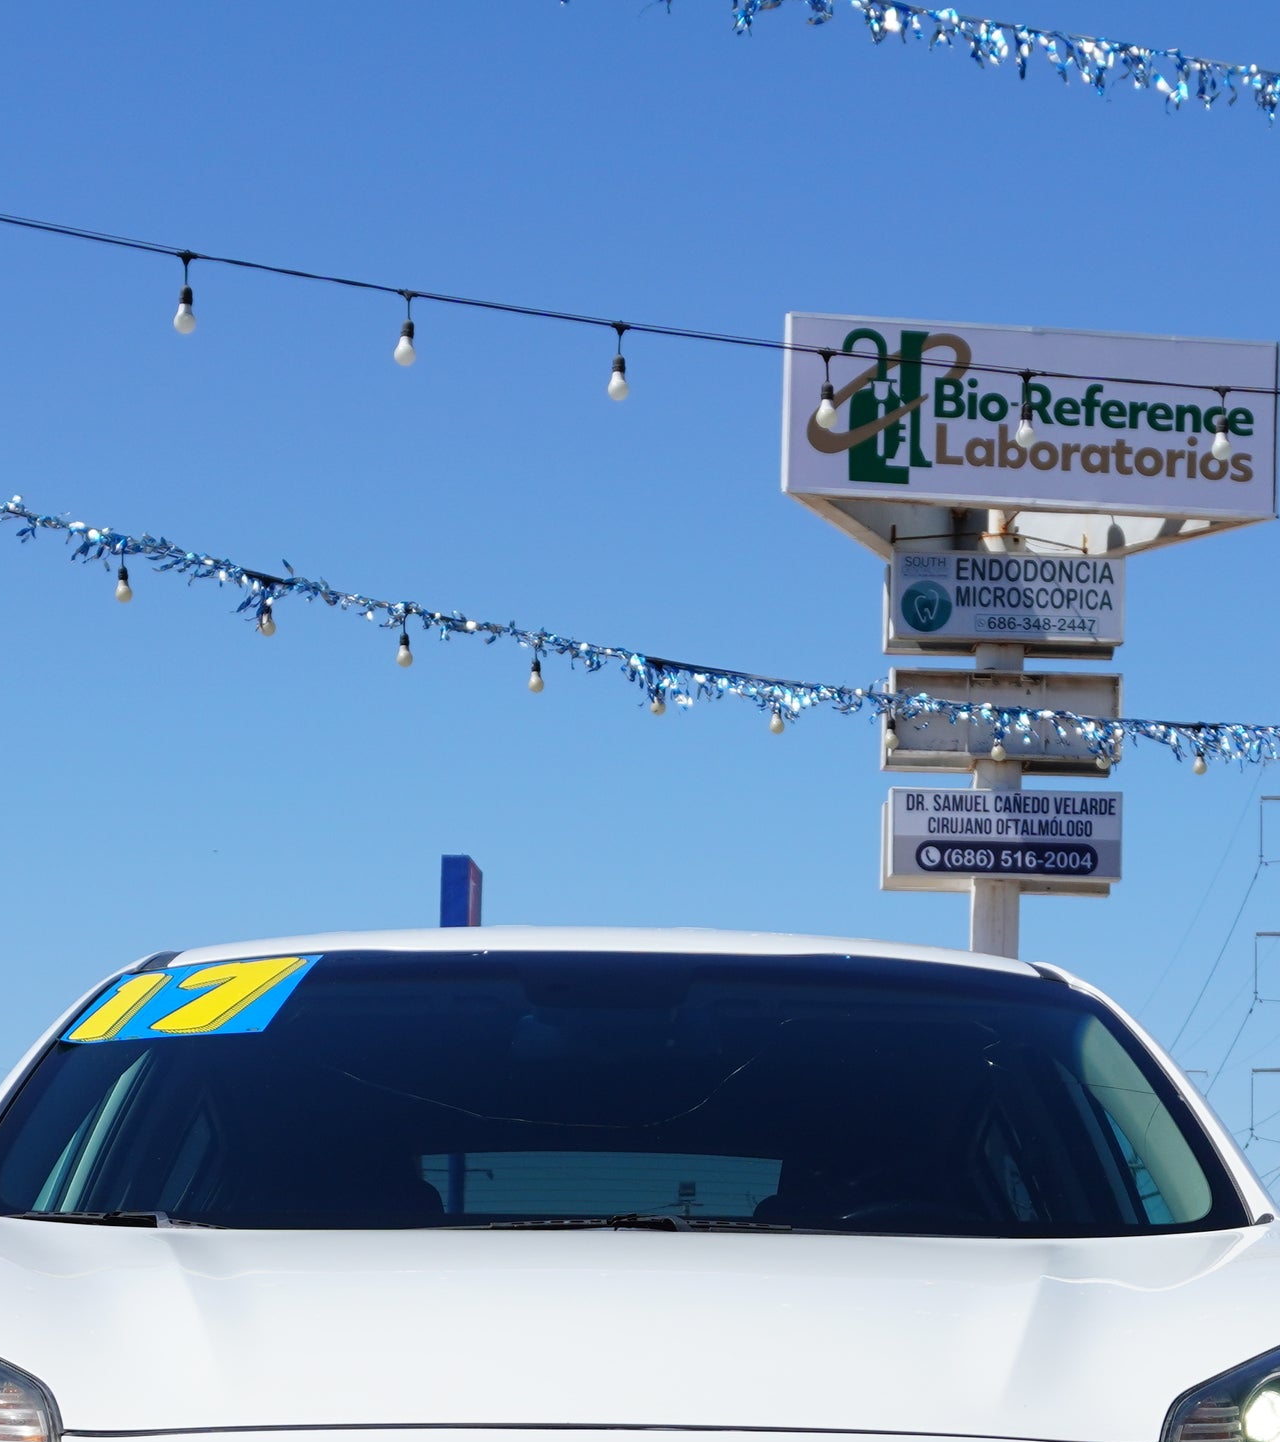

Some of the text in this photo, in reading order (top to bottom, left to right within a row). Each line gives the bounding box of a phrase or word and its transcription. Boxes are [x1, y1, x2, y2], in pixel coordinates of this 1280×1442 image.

[934, 422, 1254, 483] Laboratorios
[904, 555, 947, 568] SOUTH
[955, 557, 1114, 585] ENDODONCIA
[955, 585, 1113, 611] MICROSCOPICA
[987, 616, 1097, 632] 686-348-2447
[906, 792, 1117, 816] DR. SAMUEL CAÑEDO VELARDE
[927, 815, 1093, 837] CIRUJANO OFTALMÓLOGO
[943, 848, 1093, 869] (686) 516-2004
[68, 956, 308, 1042] 17
